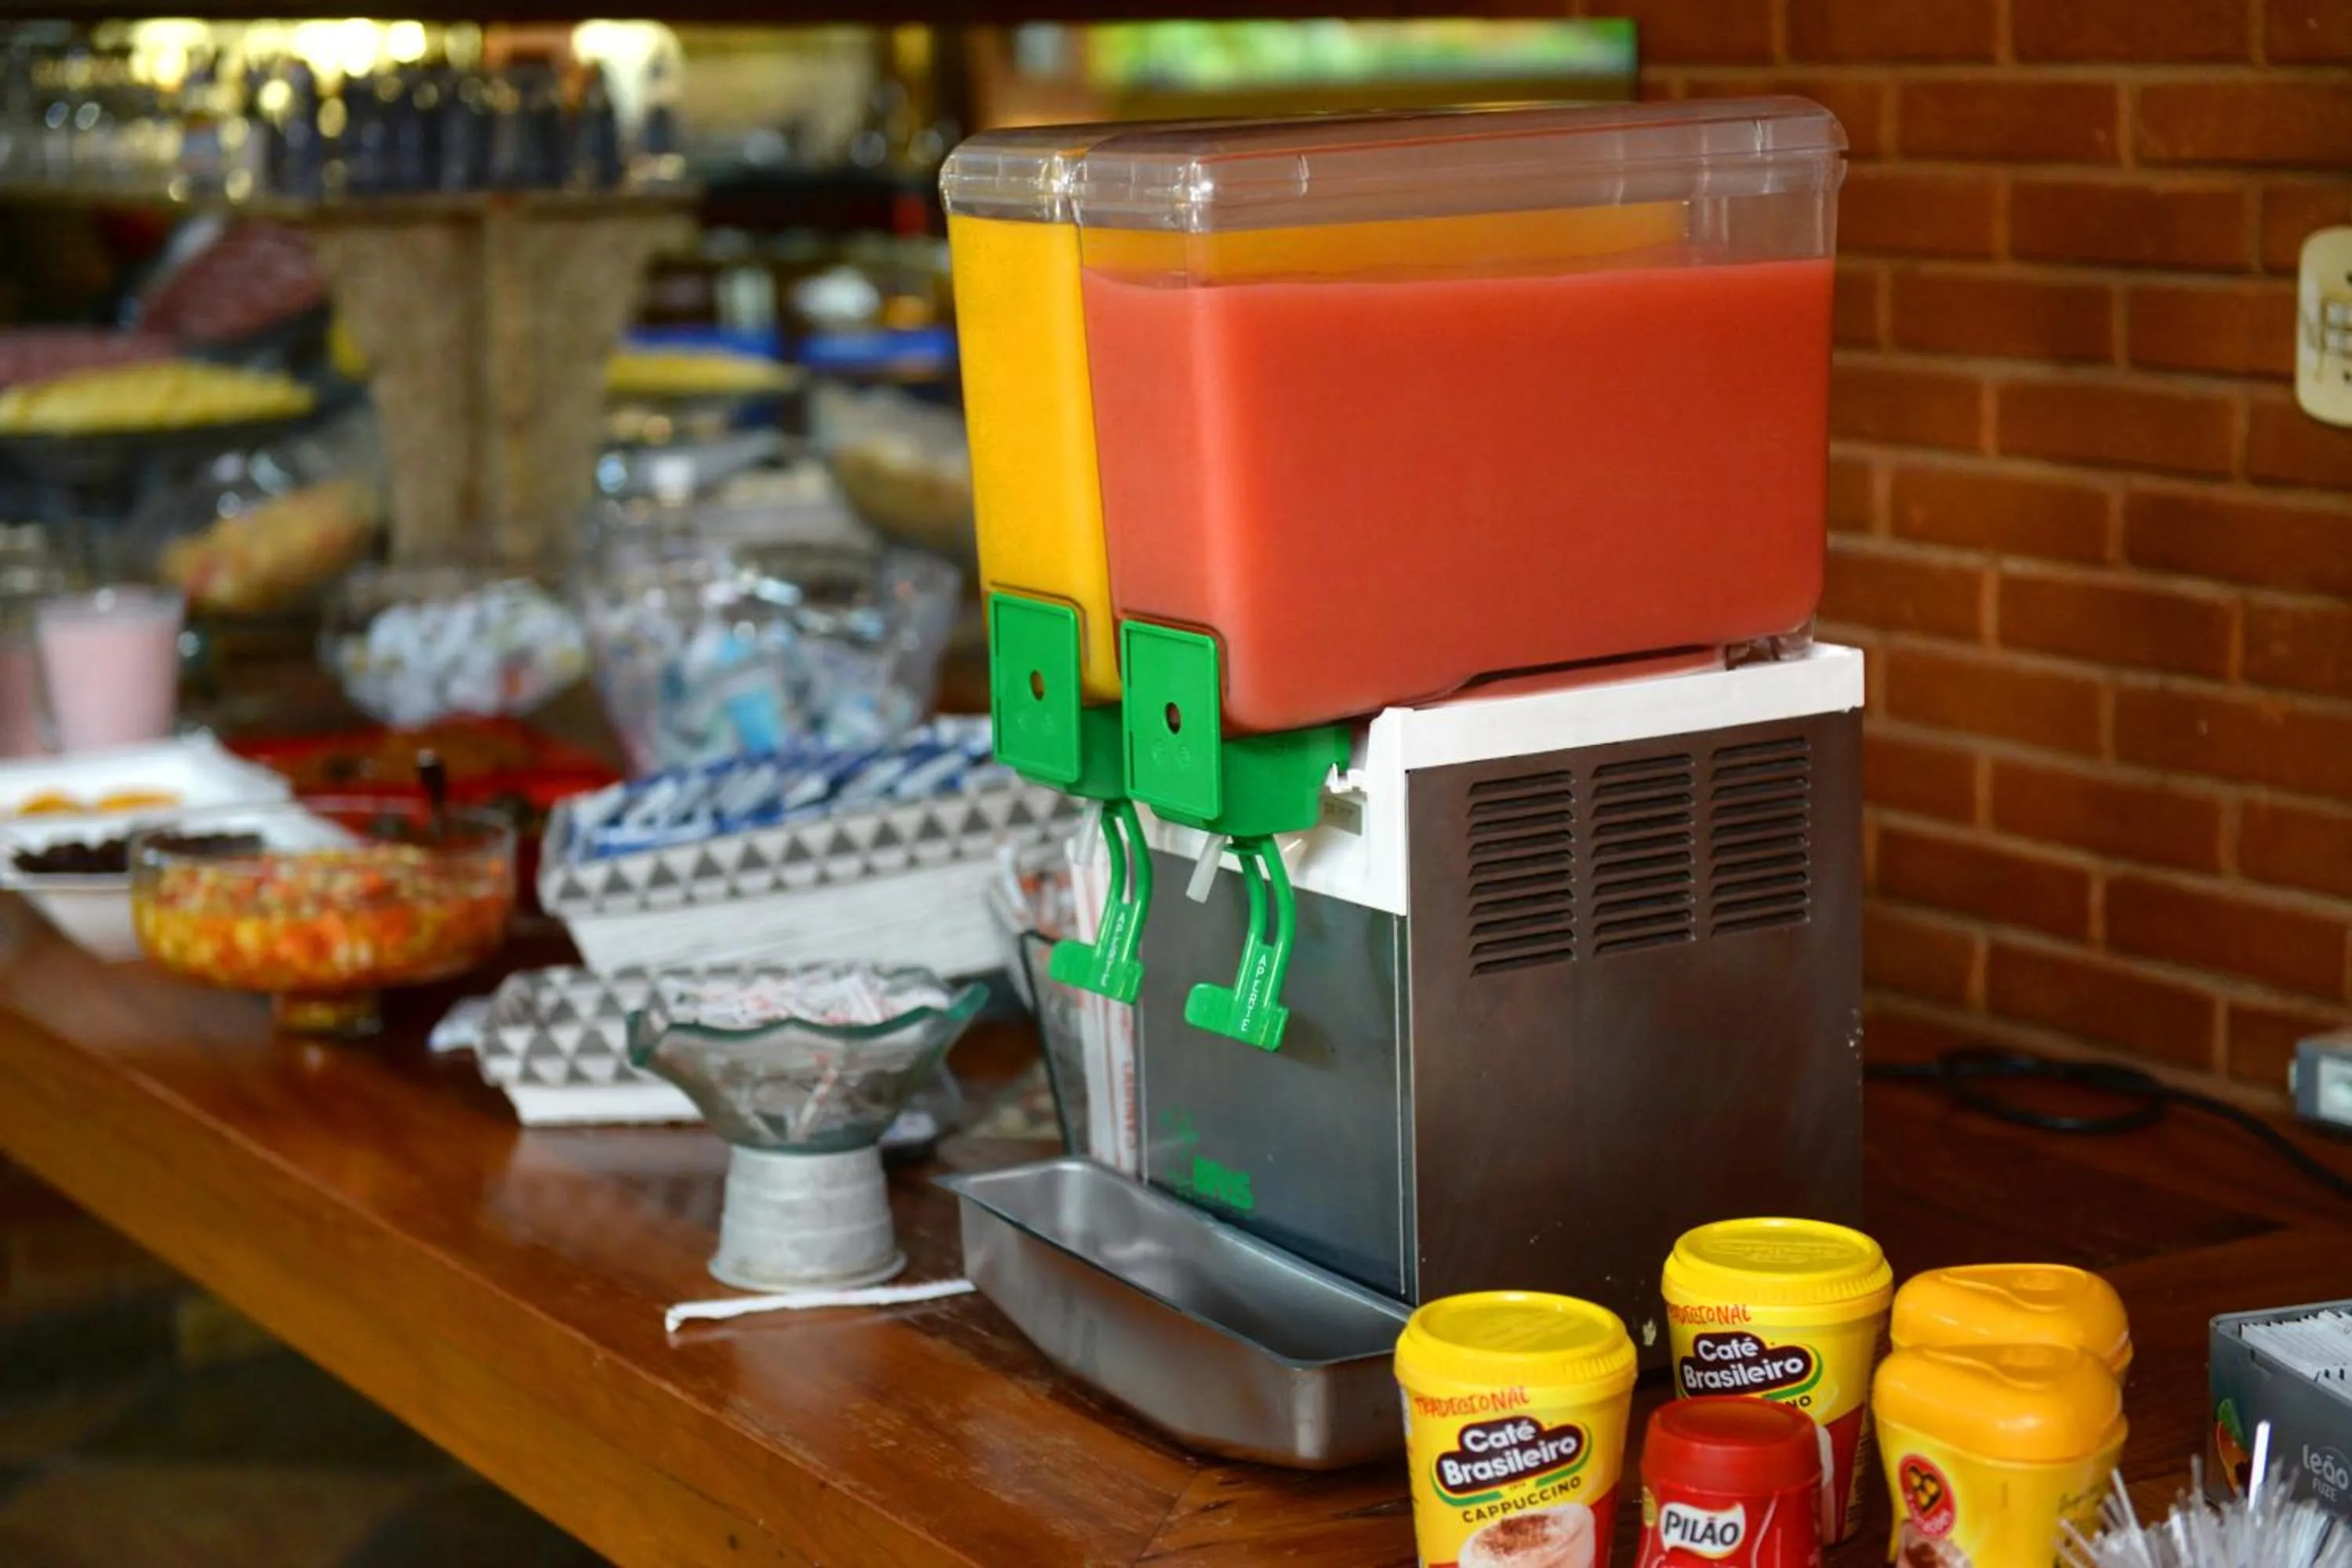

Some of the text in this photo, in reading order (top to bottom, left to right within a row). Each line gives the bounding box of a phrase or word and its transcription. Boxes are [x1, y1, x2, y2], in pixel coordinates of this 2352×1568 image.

[1697, 1337, 1759, 1362] Café
[1683, 1357, 1804, 1388] Brasileiro
[1463, 1420, 1537, 1452] Café
[1441, 1436, 1577, 1486] Brasileiro
[2302, 1443, 2349, 1490] leão
[1461, 1476, 1581, 1523] CAPPUCCINO
[1664, 1510, 1740, 1547] PILÃO
